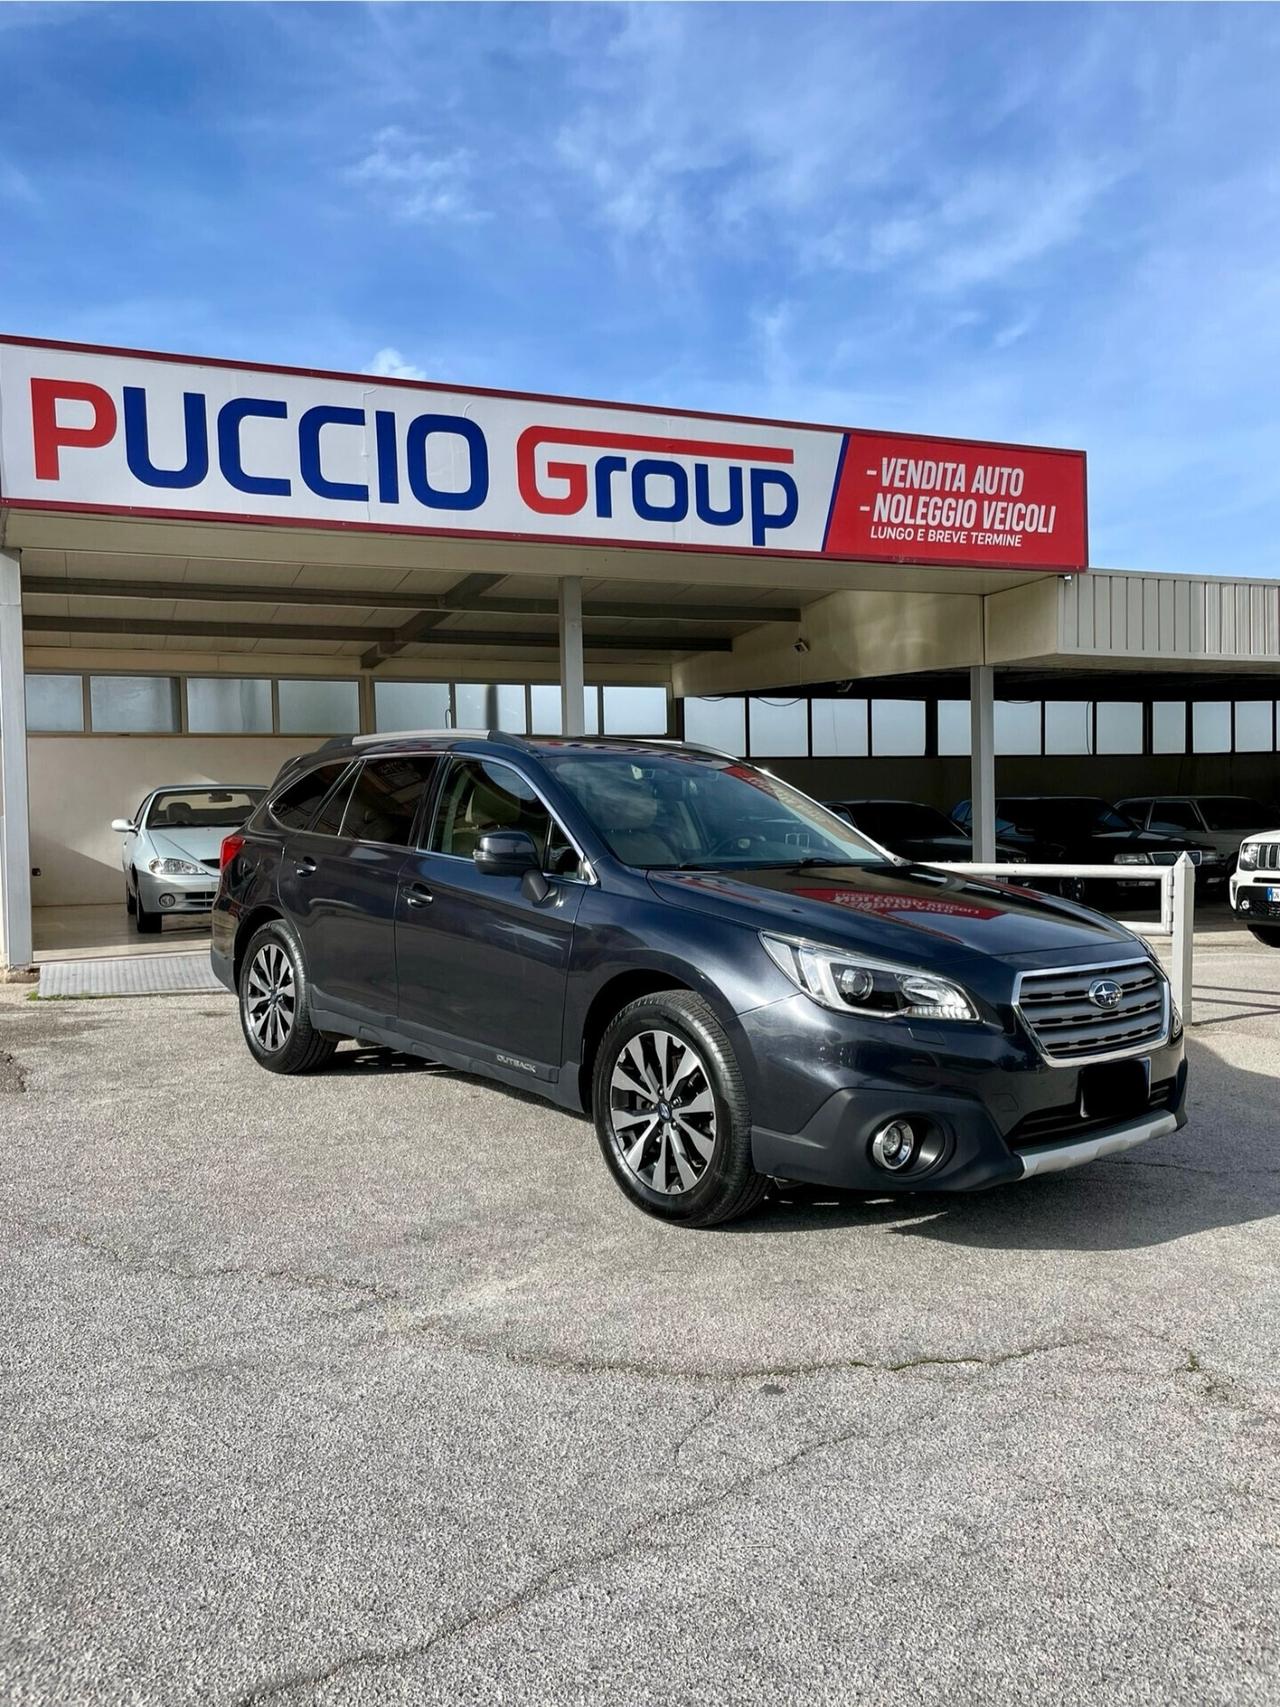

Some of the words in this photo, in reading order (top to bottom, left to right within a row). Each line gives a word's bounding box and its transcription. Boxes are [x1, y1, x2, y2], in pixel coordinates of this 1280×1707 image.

[31, 378, 489, 511] PUCCIO
[970, 465, 1024, 497] AUTO
[983, 500, 1056, 534] VEICOLI
[870, 526, 914, 541] LUNGO
[916, 528, 926, 541] E
[927, 530, 968, 544] BREVE
[970, 532, 1023, 547] TERMINE
[496, 1054, 537, 1073] OUTBACK
